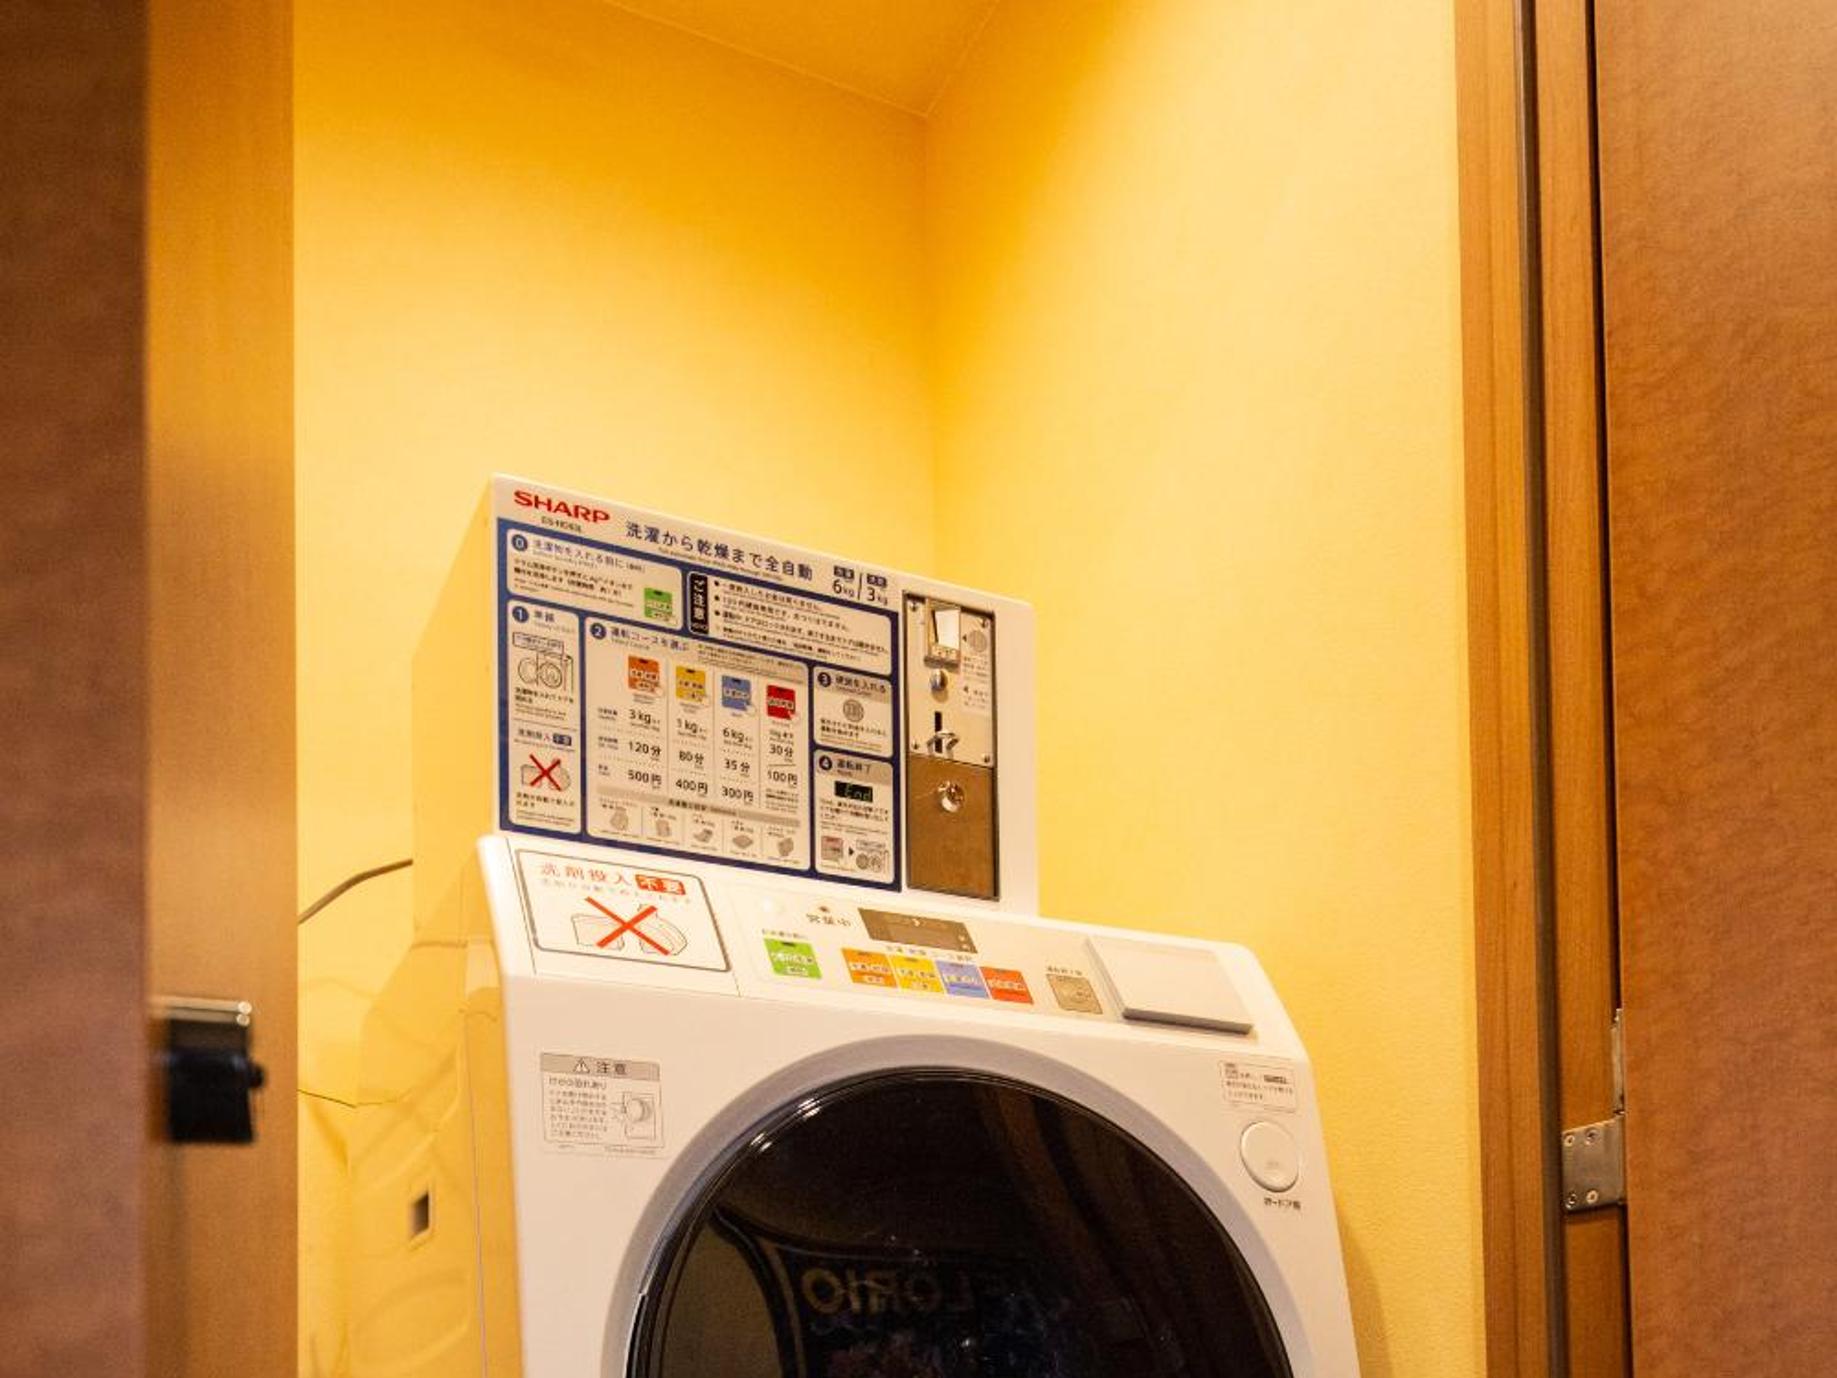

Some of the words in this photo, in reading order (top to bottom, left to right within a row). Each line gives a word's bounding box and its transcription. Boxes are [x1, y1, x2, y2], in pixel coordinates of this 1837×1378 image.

[513, 490, 611, 523] SHARP
[626, 521, 813, 581] 洗濯から乾燥まで全自動
